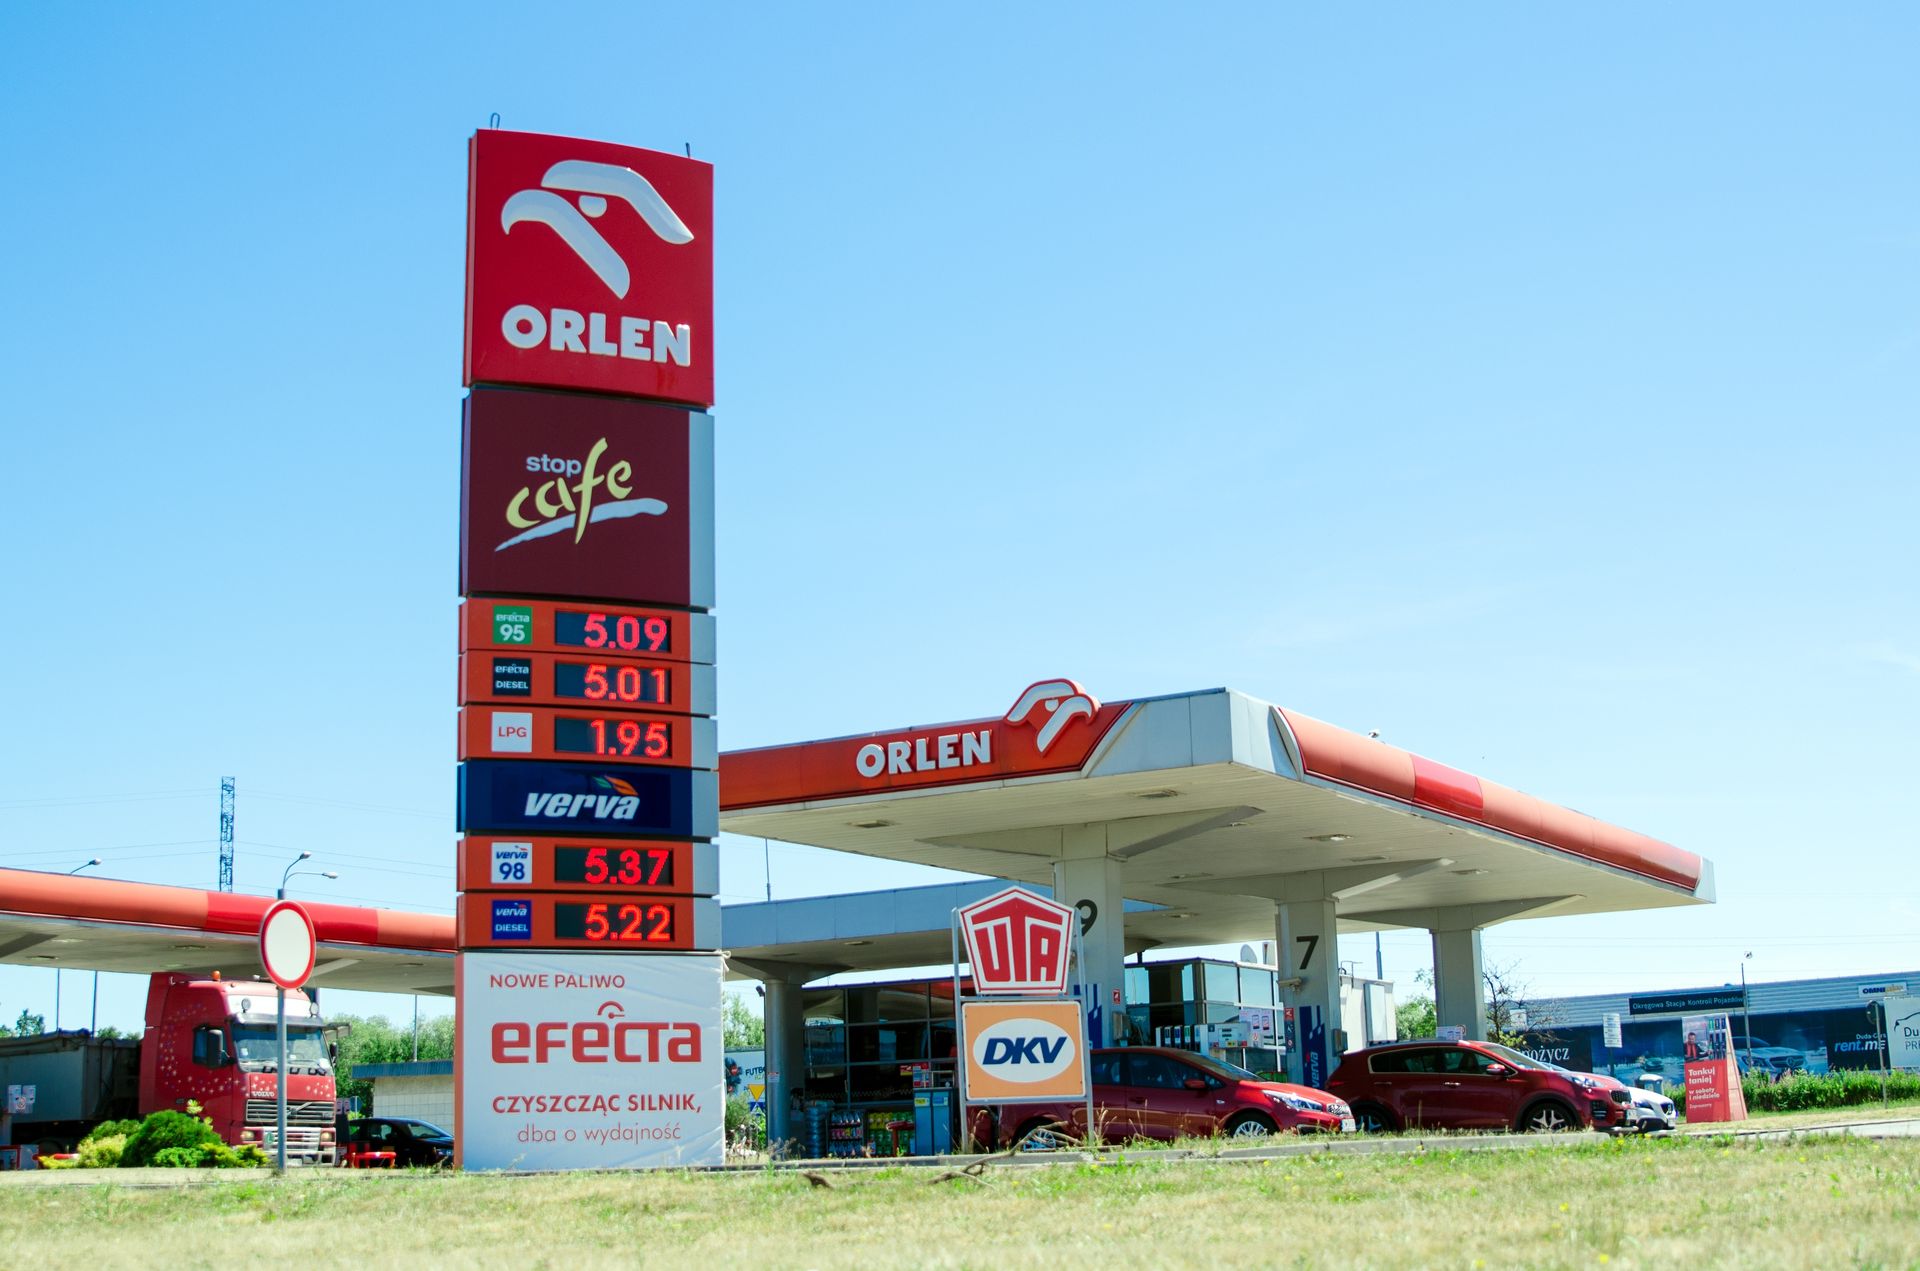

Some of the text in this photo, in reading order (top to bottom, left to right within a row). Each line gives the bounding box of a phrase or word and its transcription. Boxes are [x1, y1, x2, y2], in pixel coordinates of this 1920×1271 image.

[502, 304, 690, 367] ORLEN
[526, 454, 582, 476] stop
[505, 438, 633, 544] cafe
[500, 624, 525, 642] 95
[584, 613, 667, 651] 5.09
[495, 680, 529, 689] DIESEL
[584, 664, 665, 704] 5.01
[498, 726, 527, 738] LPG
[591, 719, 668, 758] 1.95
[856, 730, 992, 777] ORLEN
[524, 792, 640, 820] verva
[496, 851, 528, 860] verva
[585, 847, 669, 886] 5.37
[499, 862, 525, 881] 98
[496, 908, 528, 917] verva
[585, 903, 671, 942] 5.22
[1072, 899, 1098, 937] 9
[495, 923, 529, 932] DIESEL
[971, 897, 1063, 982] UTA
[1296, 935, 1319, 970] 7
[490, 974, 625, 988] NOWE PALIWO
[1665, 1000, 1686, 1008] Stacja
[491, 1022, 702, 1063] efecta
[982, 1036, 1067, 1065] DKV
[1310, 1051, 1320, 1088] verva
[1688, 1066, 1715, 1077] Tankuj
[1688, 1075, 1712, 1085] taniej
[1695, 1087, 1715, 1095] soboty
[492, 1093, 702, 1116] CZYSZCZĄC SILNIK,
[518, 1122, 682, 1145] dba o wydajność
